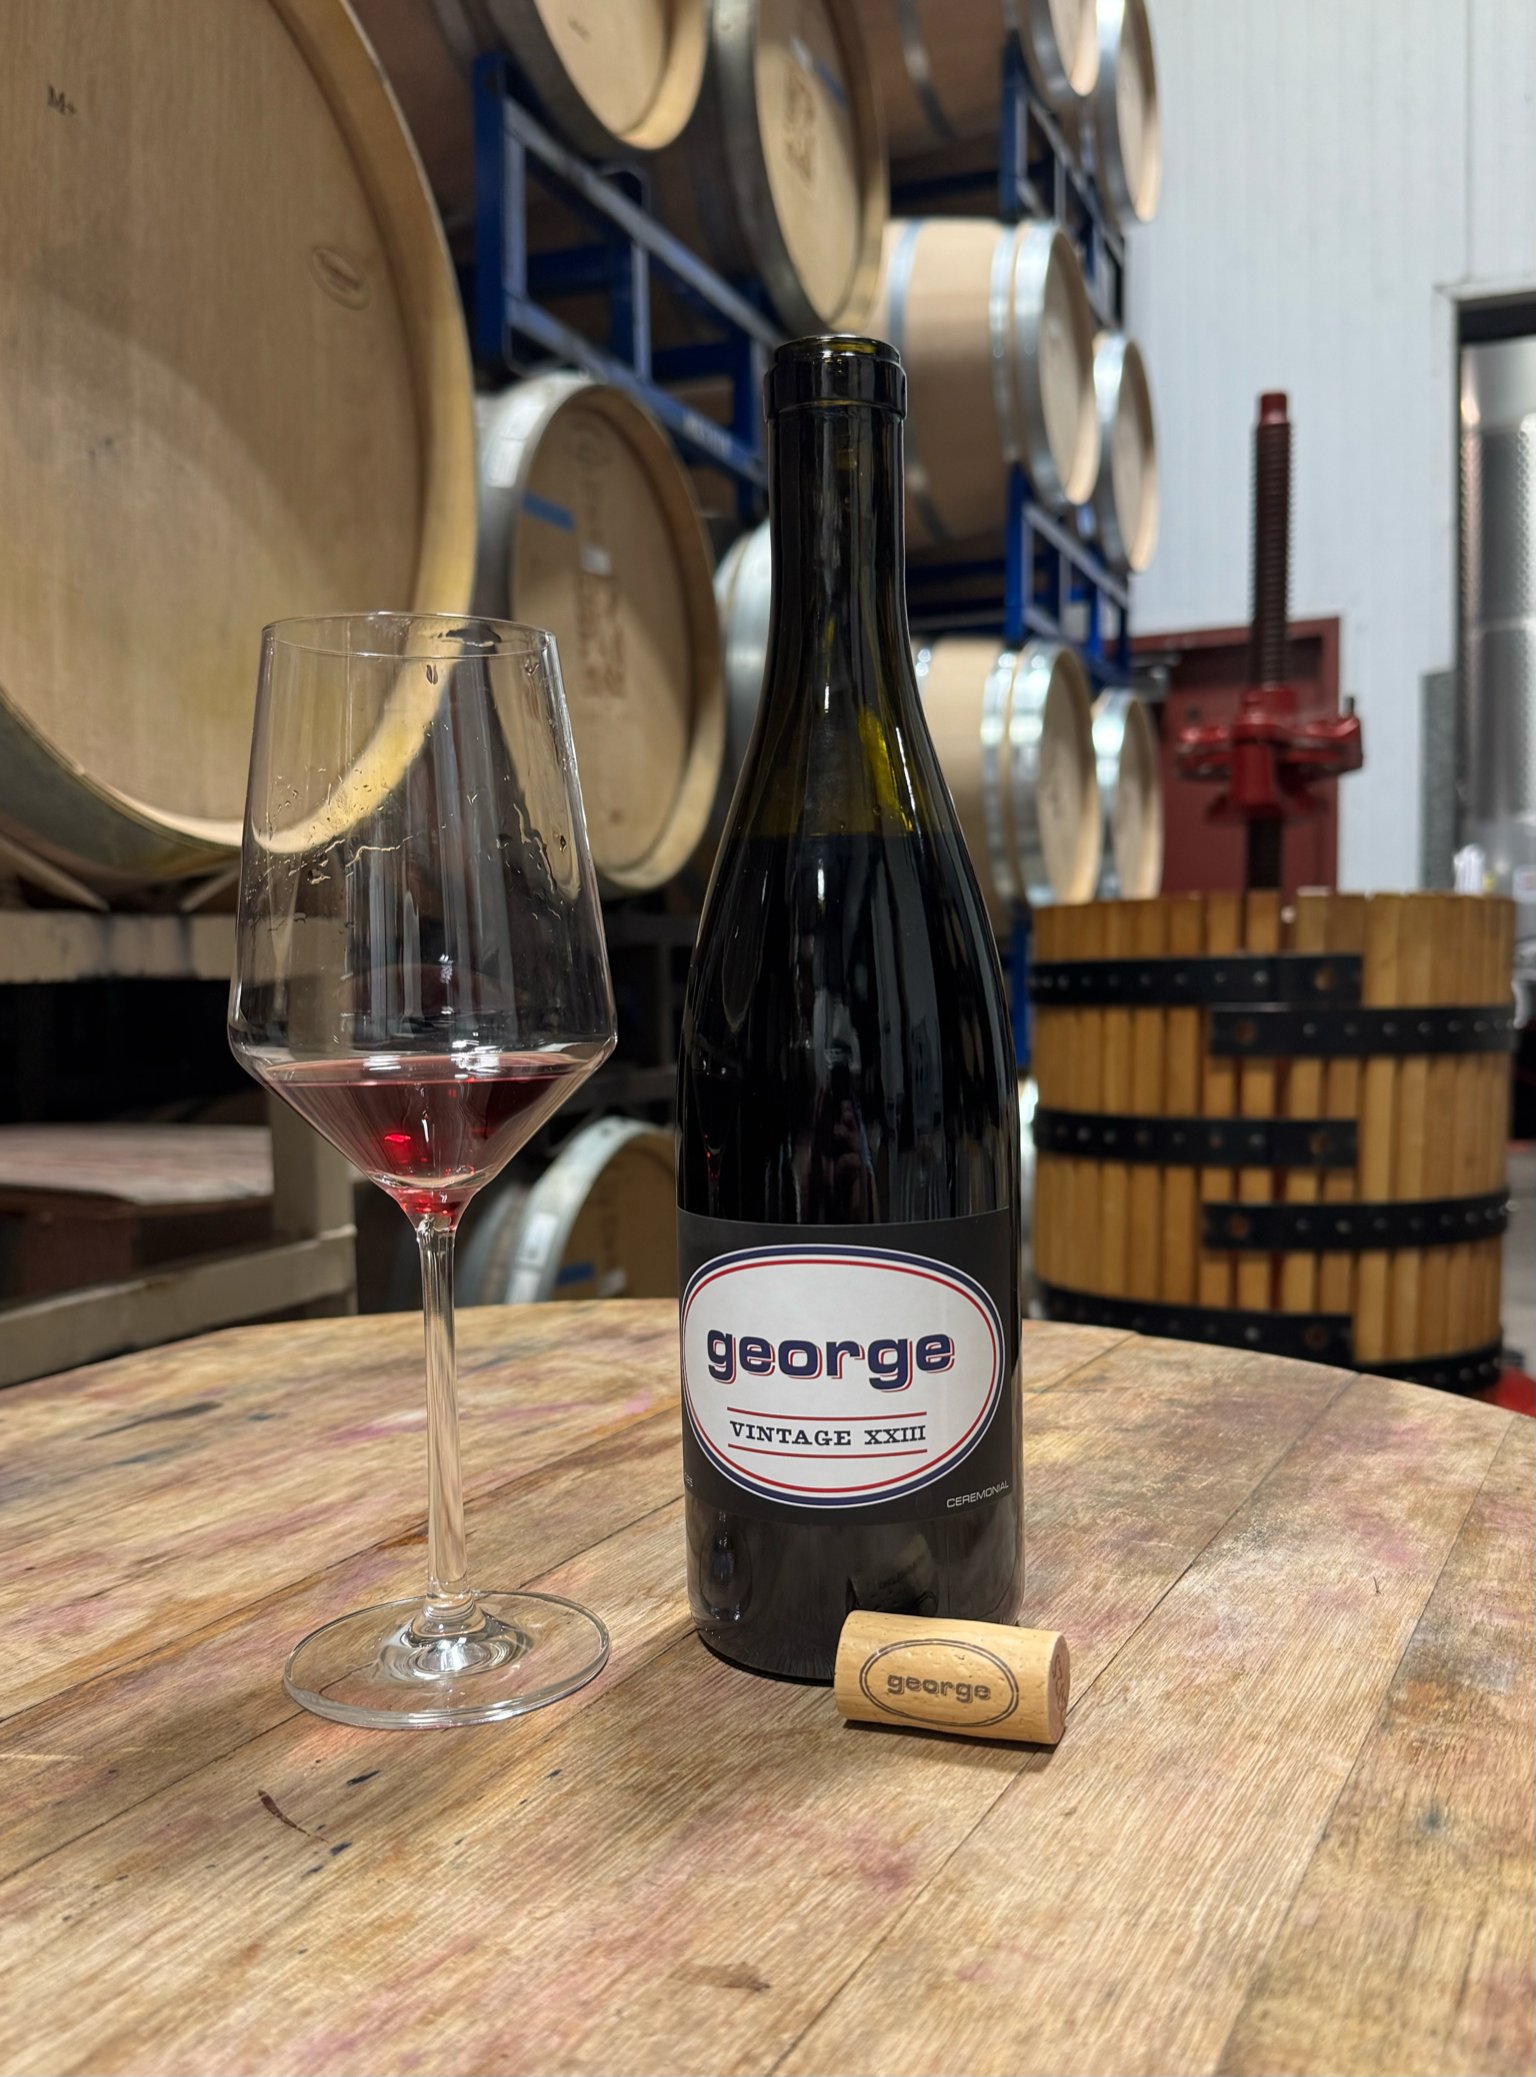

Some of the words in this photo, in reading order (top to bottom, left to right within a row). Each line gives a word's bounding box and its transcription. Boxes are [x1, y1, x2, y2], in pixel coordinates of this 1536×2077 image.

[707, 1329, 955, 1392] george
[729, 1420, 851, 1446] VINTAGE
[864, 1425, 926, 1445] XXIII
[887, 1674, 992, 1703] george
